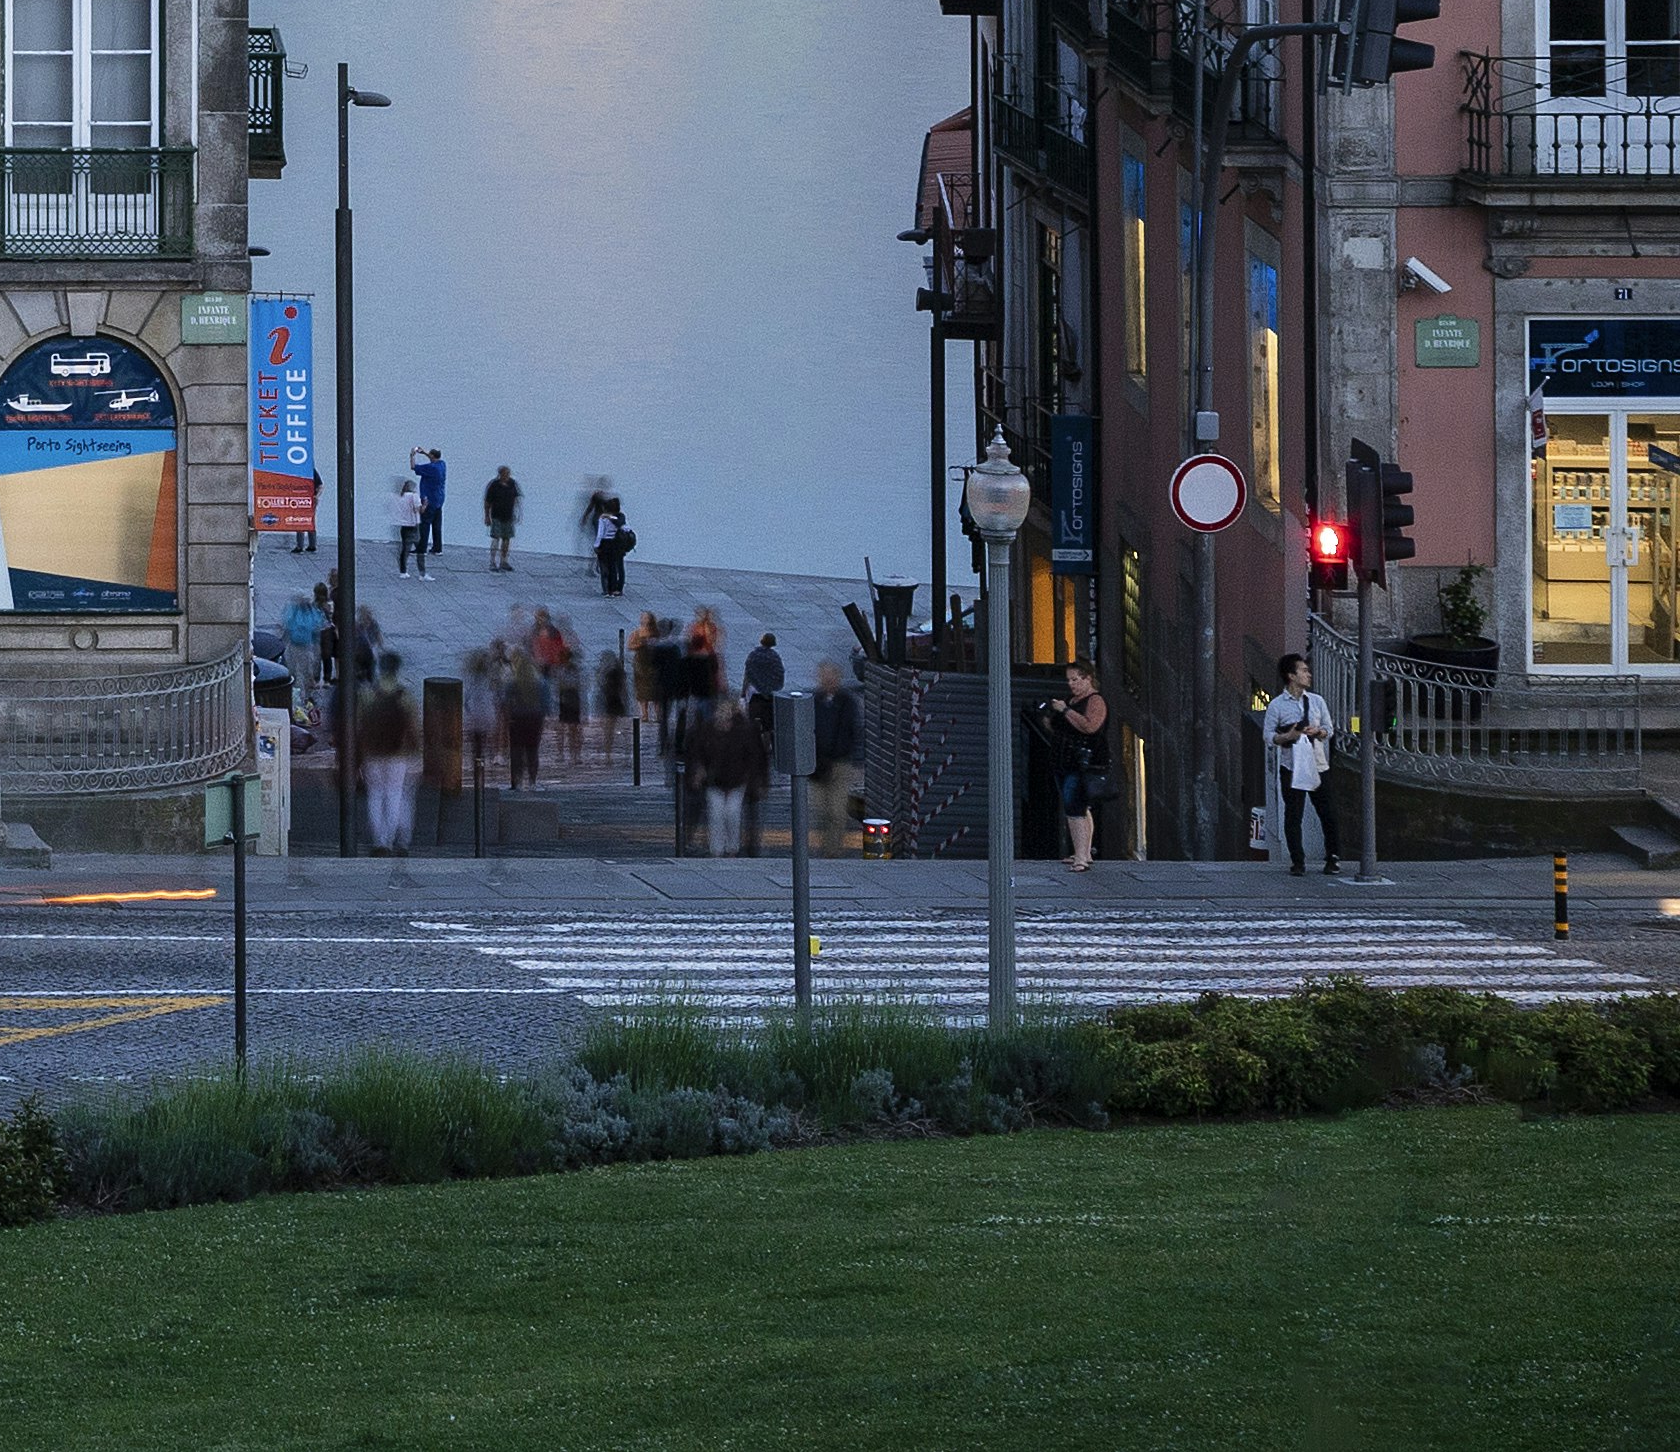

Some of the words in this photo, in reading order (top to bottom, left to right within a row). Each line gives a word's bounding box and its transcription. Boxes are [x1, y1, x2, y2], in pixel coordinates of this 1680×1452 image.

[1618, 289, 1628, 299] 71
[198, 305, 229, 314] INFANTE
[199, 316, 237, 326] HENRIQUE
[259, 370, 279, 464] TICKET
[286, 369, 308, 465] OFFICE
[27, 437, 61, 452] Porto
[65, 438, 132, 455] Sightseeing
